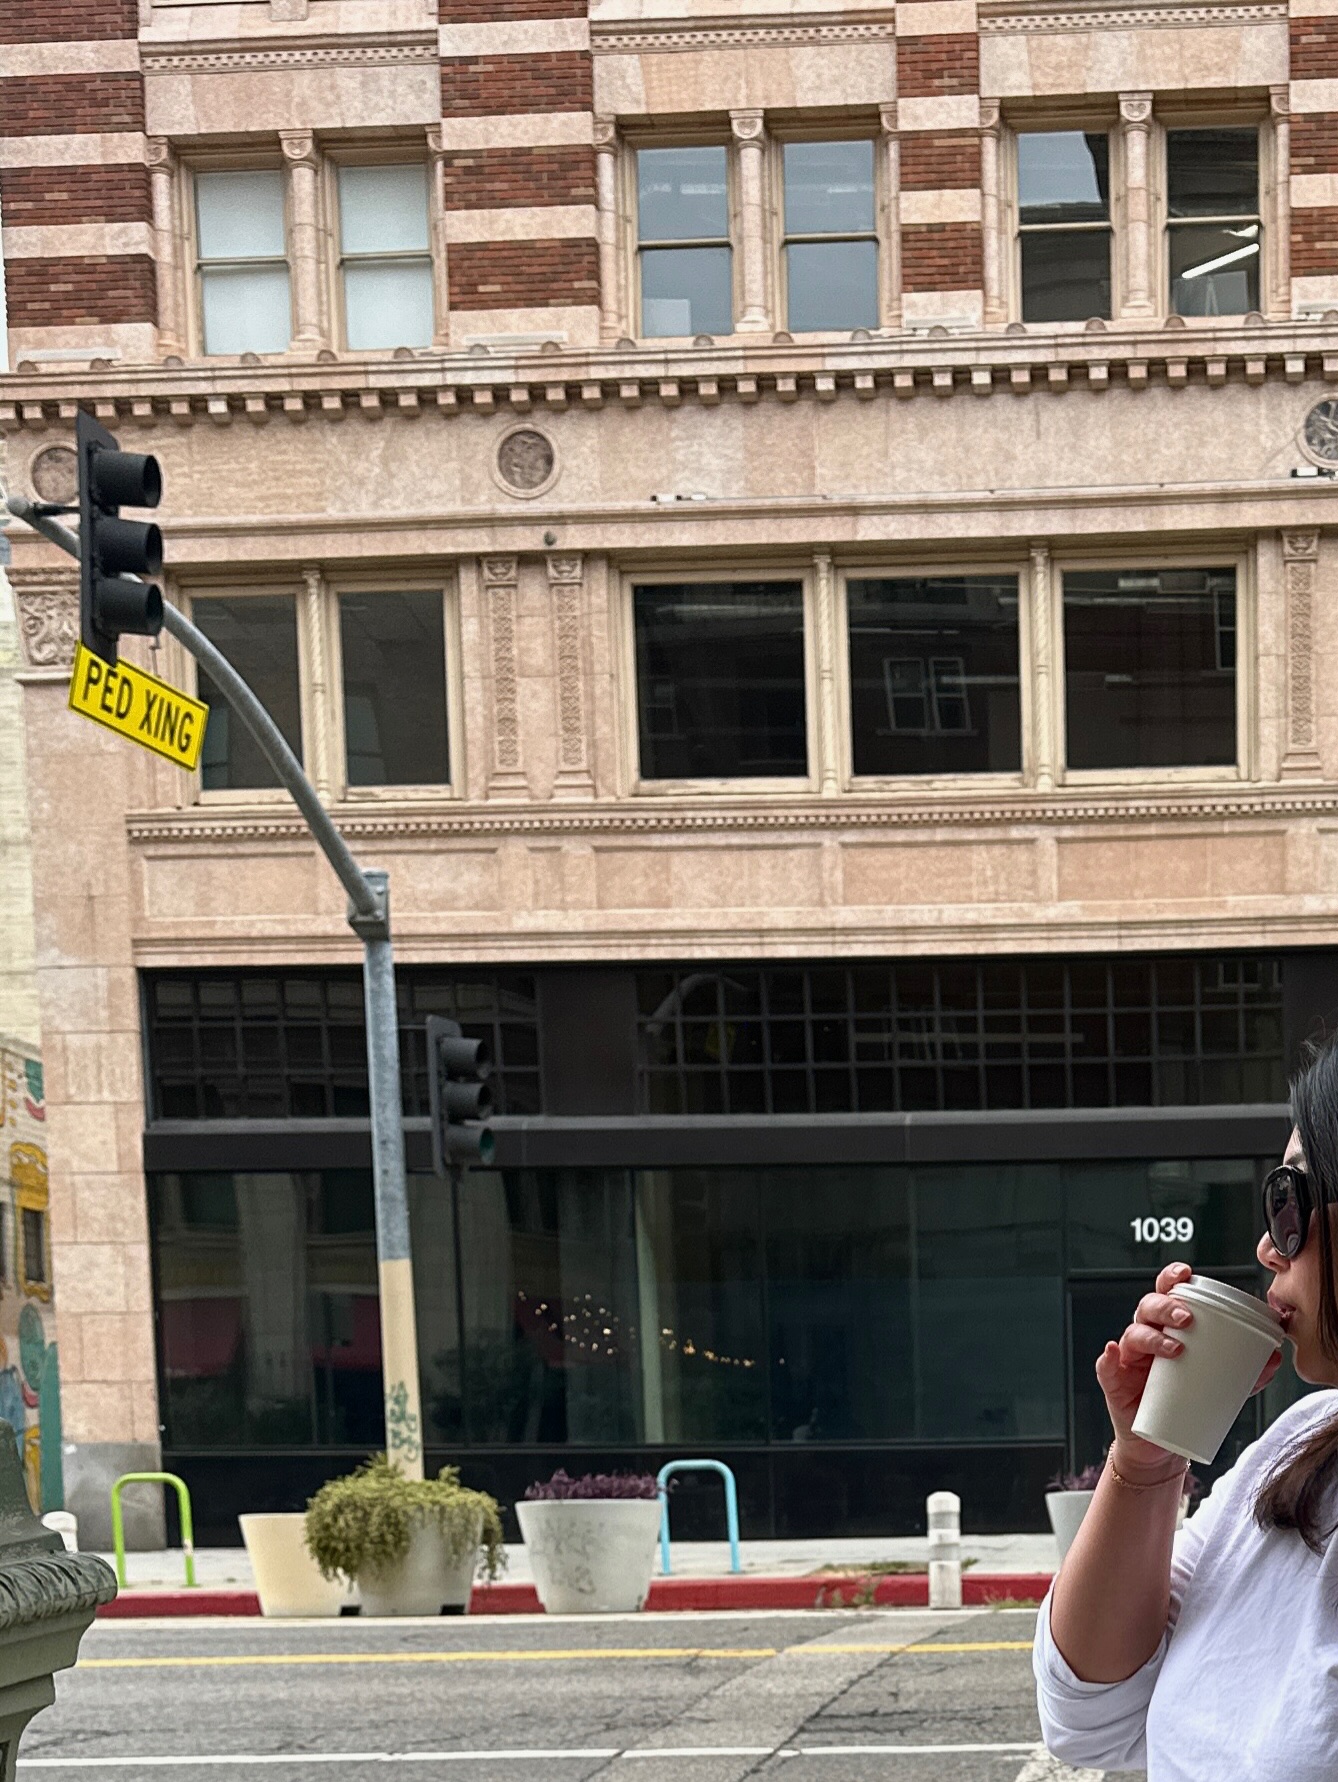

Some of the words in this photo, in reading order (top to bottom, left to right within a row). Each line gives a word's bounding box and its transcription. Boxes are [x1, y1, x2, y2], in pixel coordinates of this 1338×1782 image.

[82, 657, 133, 720] PED
[139, 688, 194, 753] XING
[1130, 1216, 1194, 1243] 1039
